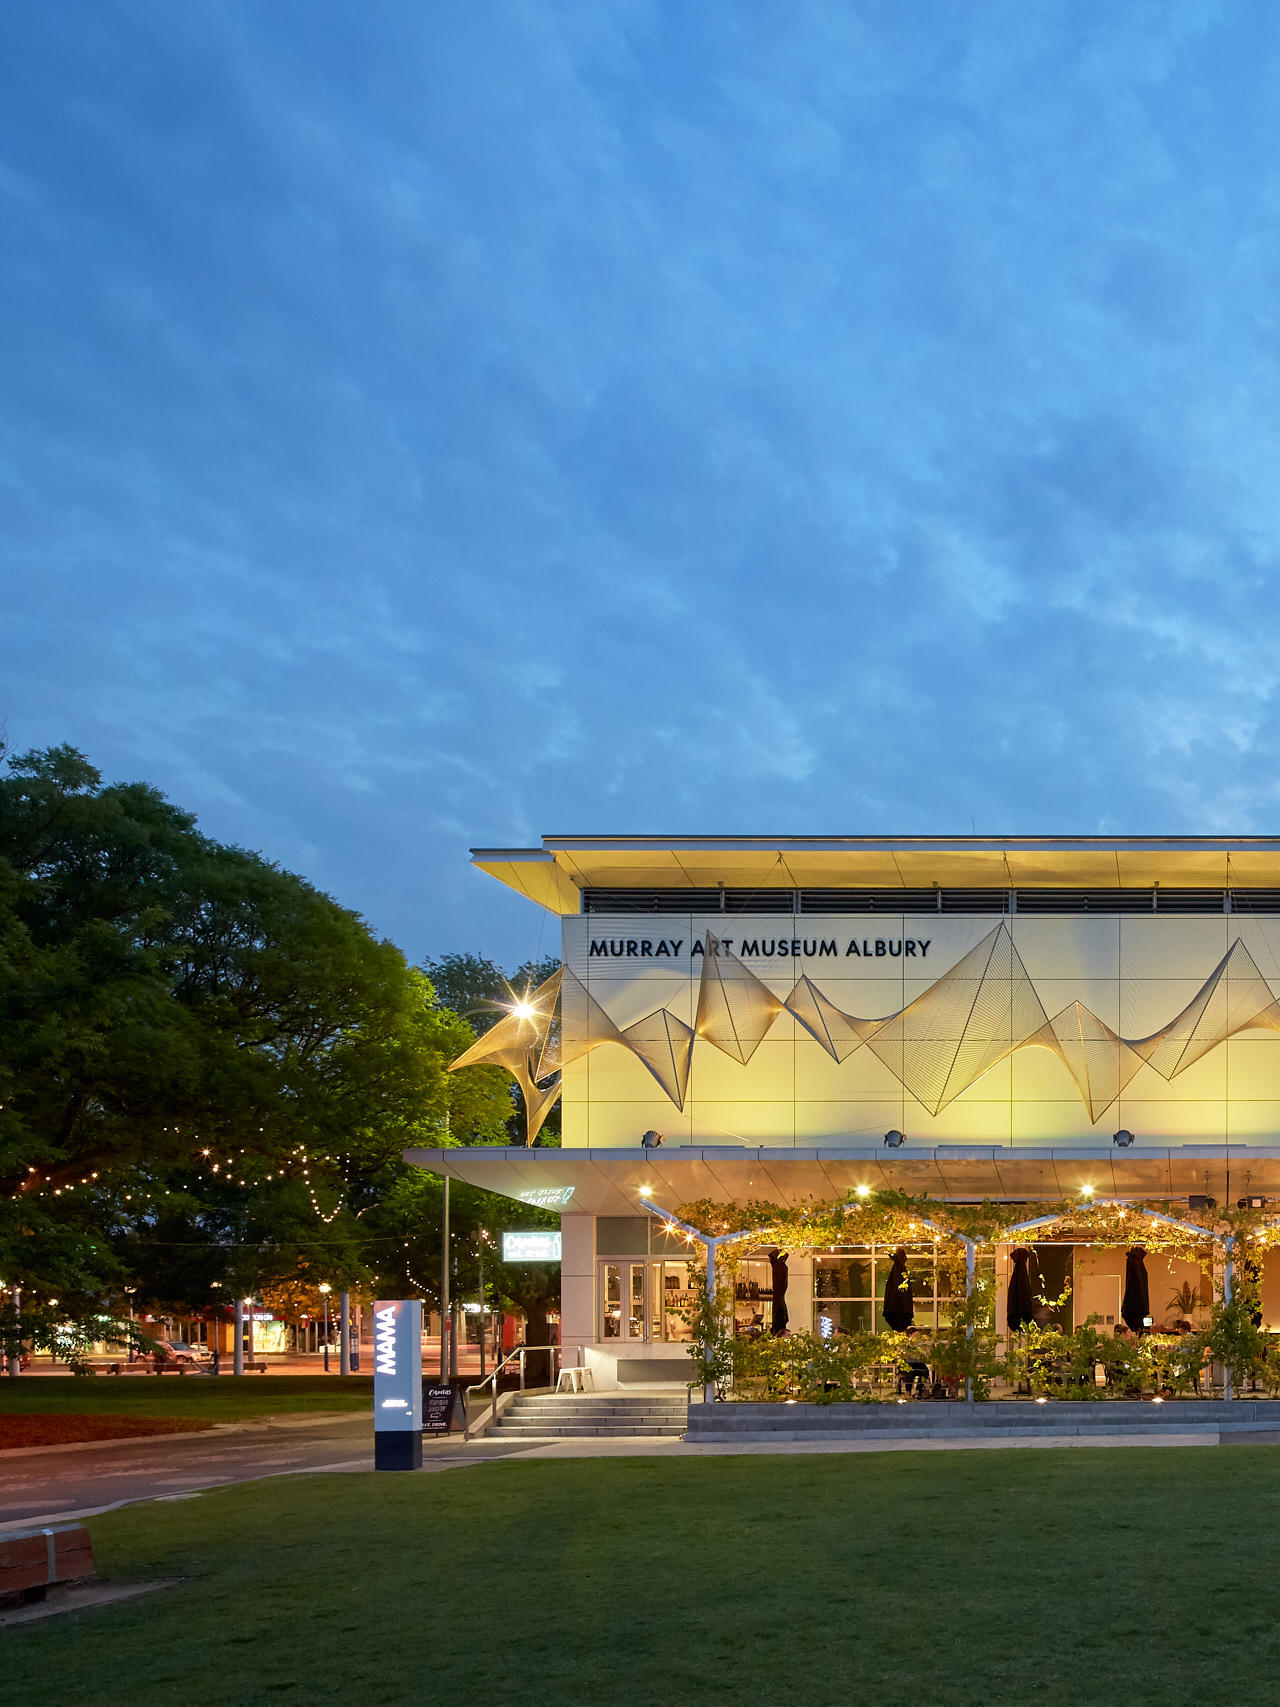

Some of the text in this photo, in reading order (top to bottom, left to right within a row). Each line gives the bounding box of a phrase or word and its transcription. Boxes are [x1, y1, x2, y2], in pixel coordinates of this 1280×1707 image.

[589, 939, 932, 957] MURRAY ART MUSEUM ALBURY
[376, 1305, 397, 1376] MAMA
